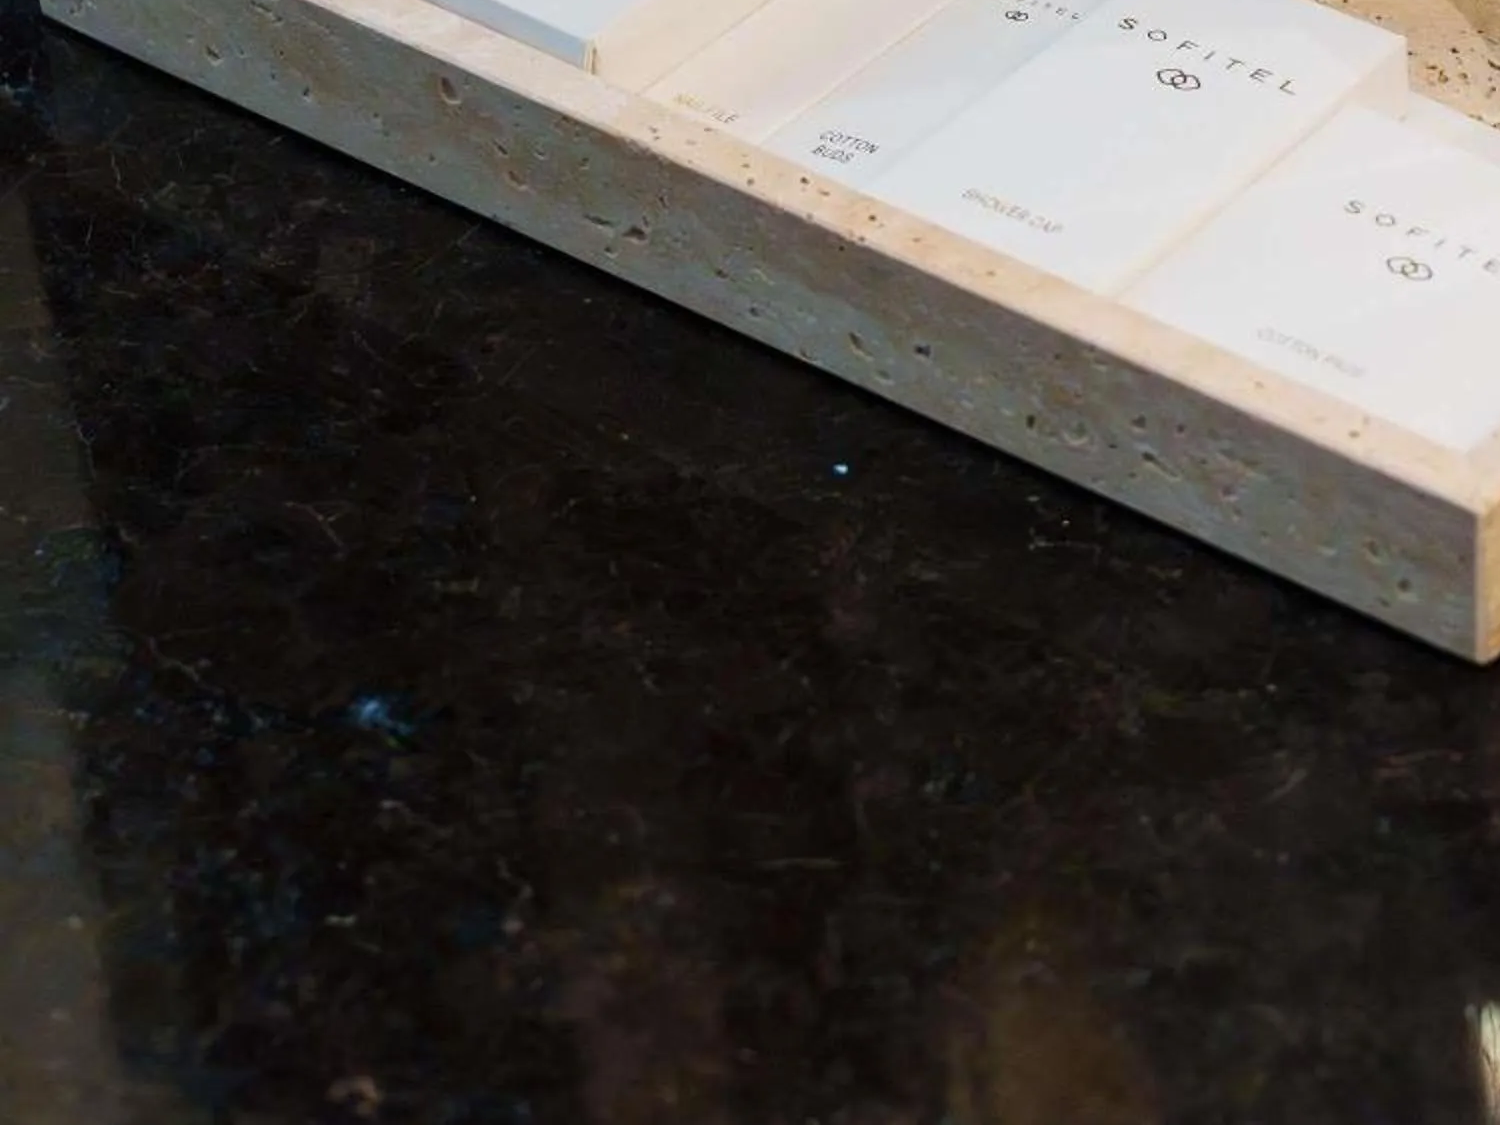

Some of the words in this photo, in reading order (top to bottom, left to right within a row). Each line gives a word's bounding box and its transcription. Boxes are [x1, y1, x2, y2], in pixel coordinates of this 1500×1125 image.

[1118, 17, 1298, 97] SOFITEL
[811, 144, 855, 164] BUDS
[819, 129, 880, 154] COTTON
